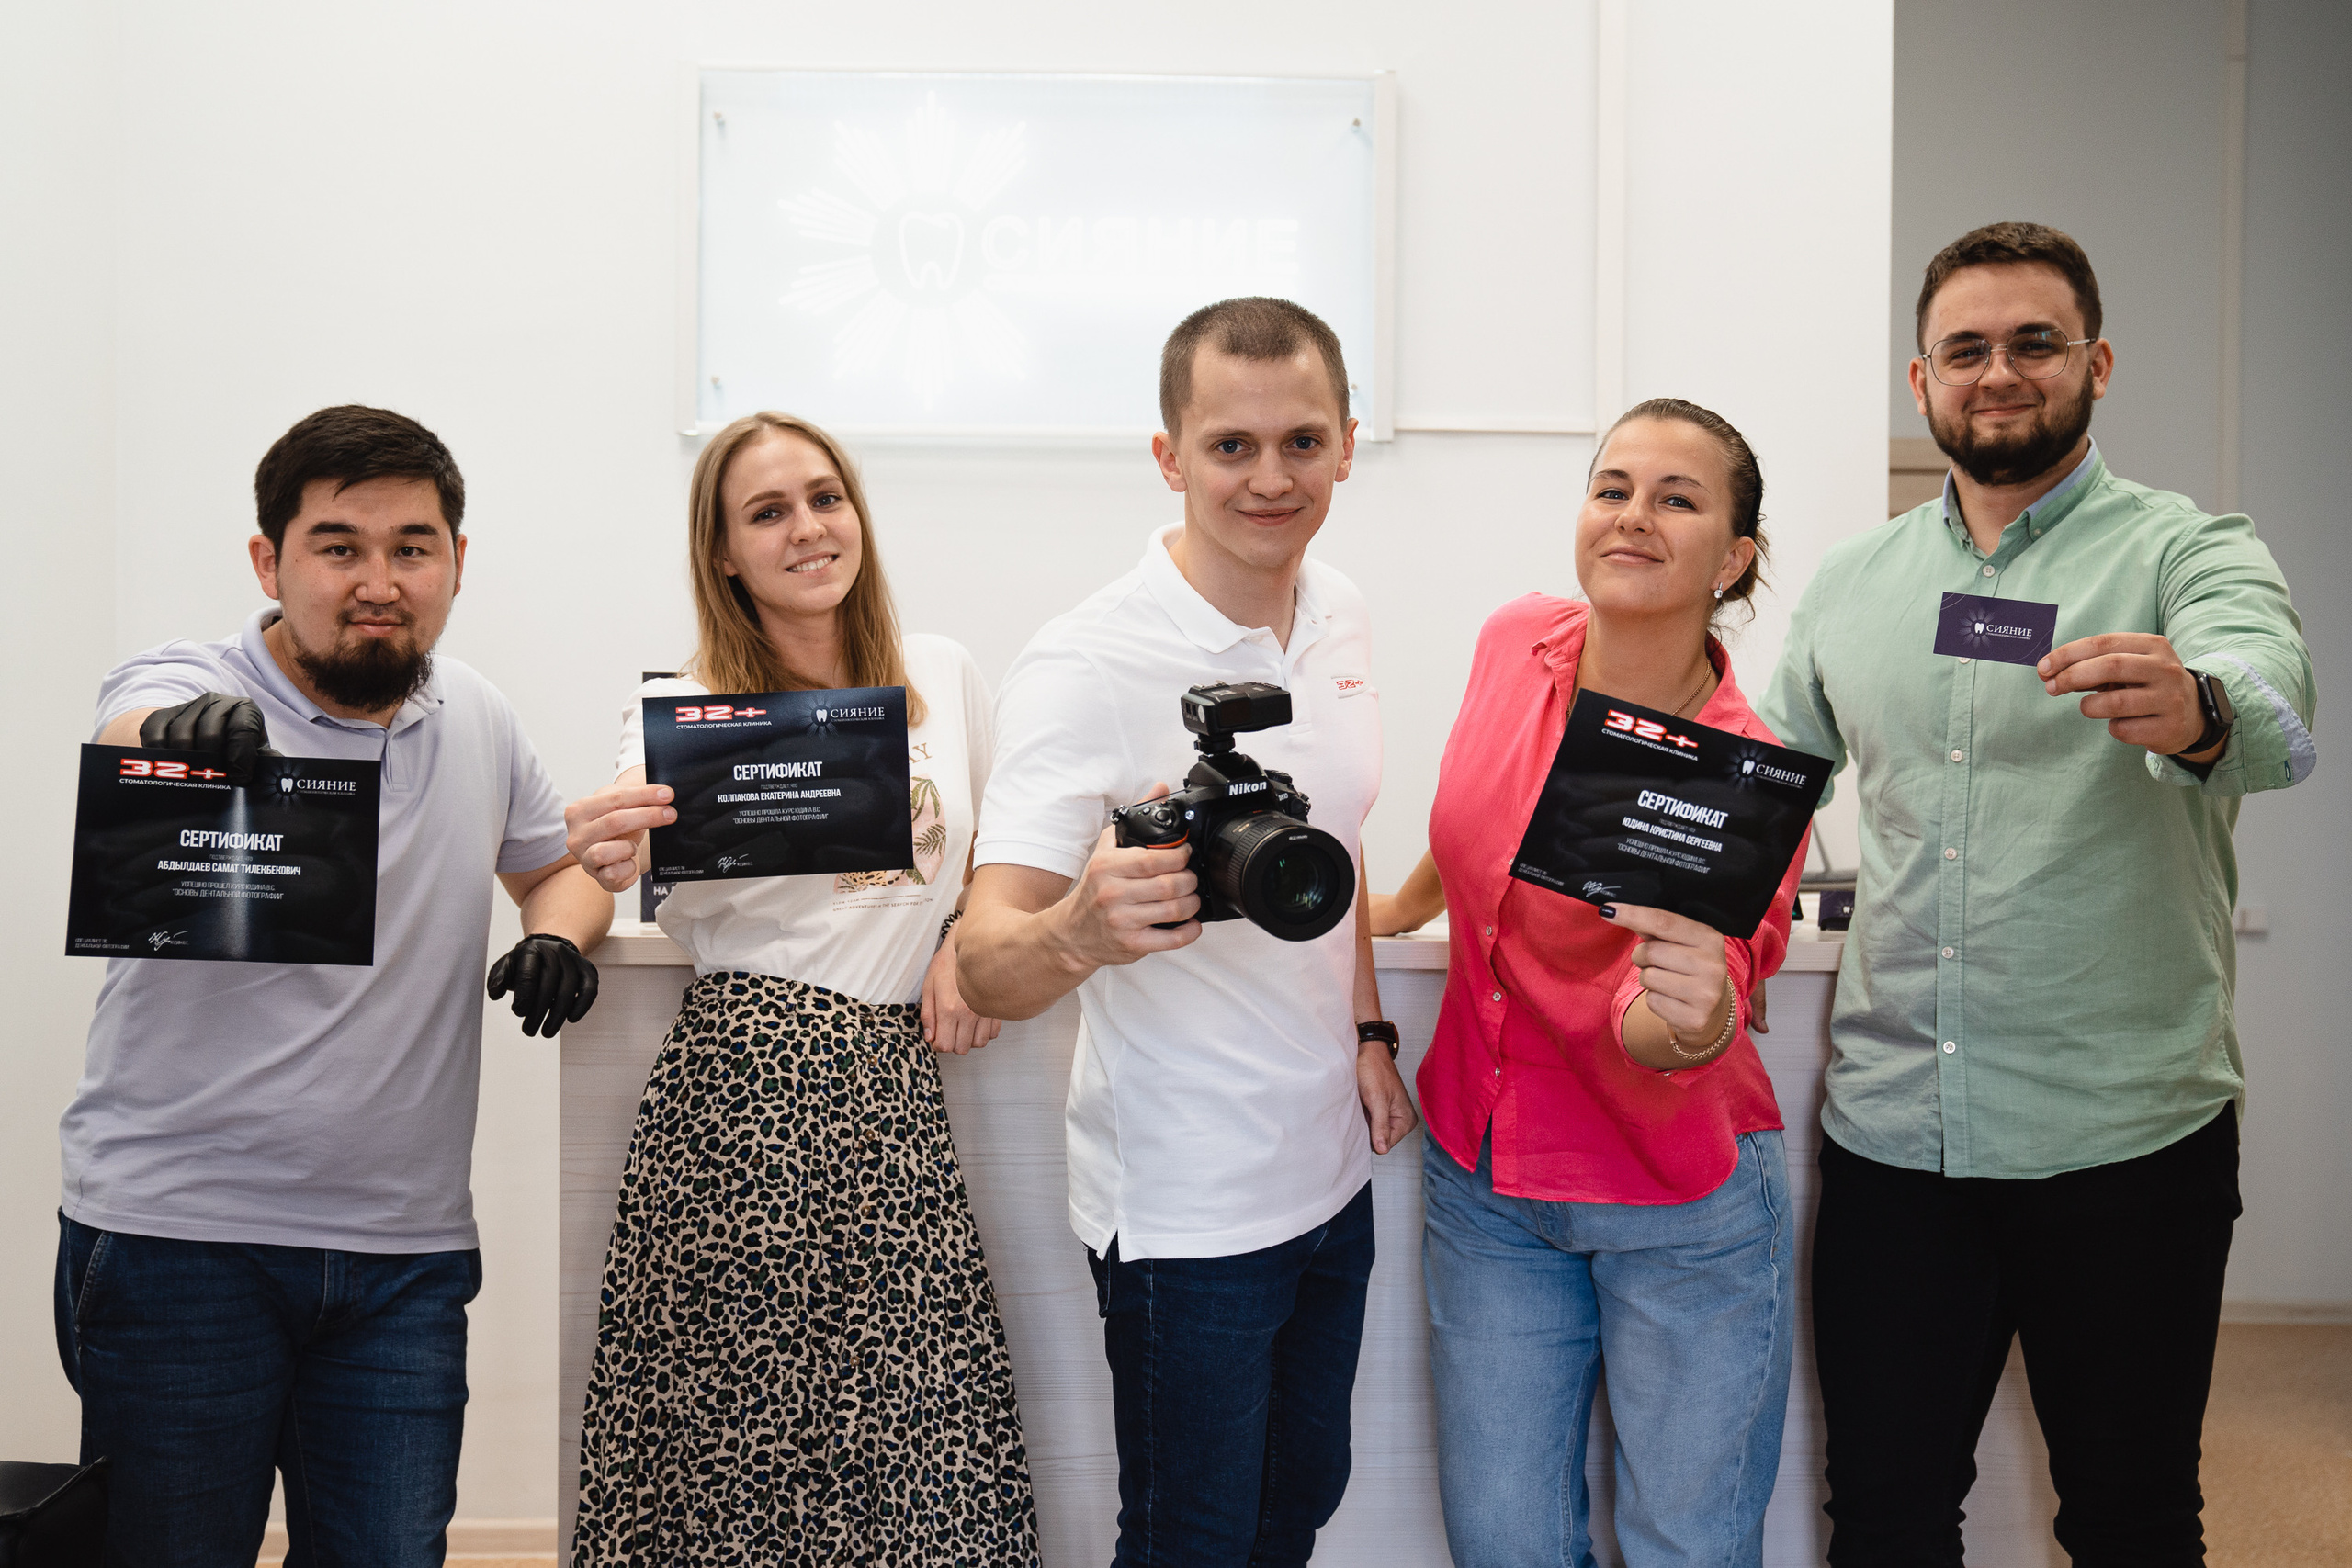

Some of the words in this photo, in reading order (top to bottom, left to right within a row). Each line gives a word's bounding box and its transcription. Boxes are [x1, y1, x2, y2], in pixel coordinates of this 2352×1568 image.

[980, 214, 1300, 275] СИЯНИЕ
[1985, 624, 2033, 637] СИЯНИЕ
[675, 705, 766, 722] 32+
[830, 707, 885, 718] СИЯНИЕ
[1604, 709, 1699, 748] 32+
[1601, 728, 1669, 752] СТОМАТОЛОГИЧЕСКАЯ
[1668, 748, 1699, 761] КЛИНИКА
[120, 759, 227, 780] 32+
[733, 761, 823, 781] СЕРТИФИКАТ
[1756, 764, 1807, 785] СИЯНИЕ
[119, 778, 198, 788] СТОМАТОЛОГИЧЕСКАЯ
[296, 779, 356, 792] СИЯНИЕ
[1228, 781, 1267, 796] Nikon
[718, 792, 759, 803] КОЛПАКОВА
[761, 790, 799, 801] ЕКАТЕРИНА
[800, 788, 842, 798] АНДРЕЕВНА
[1637, 789, 1728, 829] СЕРТИФИКАТ
[756, 815, 790, 823] ДЕНТАЛЬНОЙ
[179, 829, 284, 852] СЕРТИФИКАТ
[1622, 816, 1650, 833] ЮДИНА
[1649, 825, 1686, 843] КРИСТИНА
[1686, 834, 1723, 852] СЕРГЕЕВНА
[157, 860, 211, 872] АБДЫЛДАЕВ
[211, 863, 239, 873] САМАТ
[241, 864, 301, 875] ТИЛЕКБЕКОВИЧ
[199, 889, 240, 897] ДЕНТАЛЬНОЙ
[653, 886, 668, 896] НА
